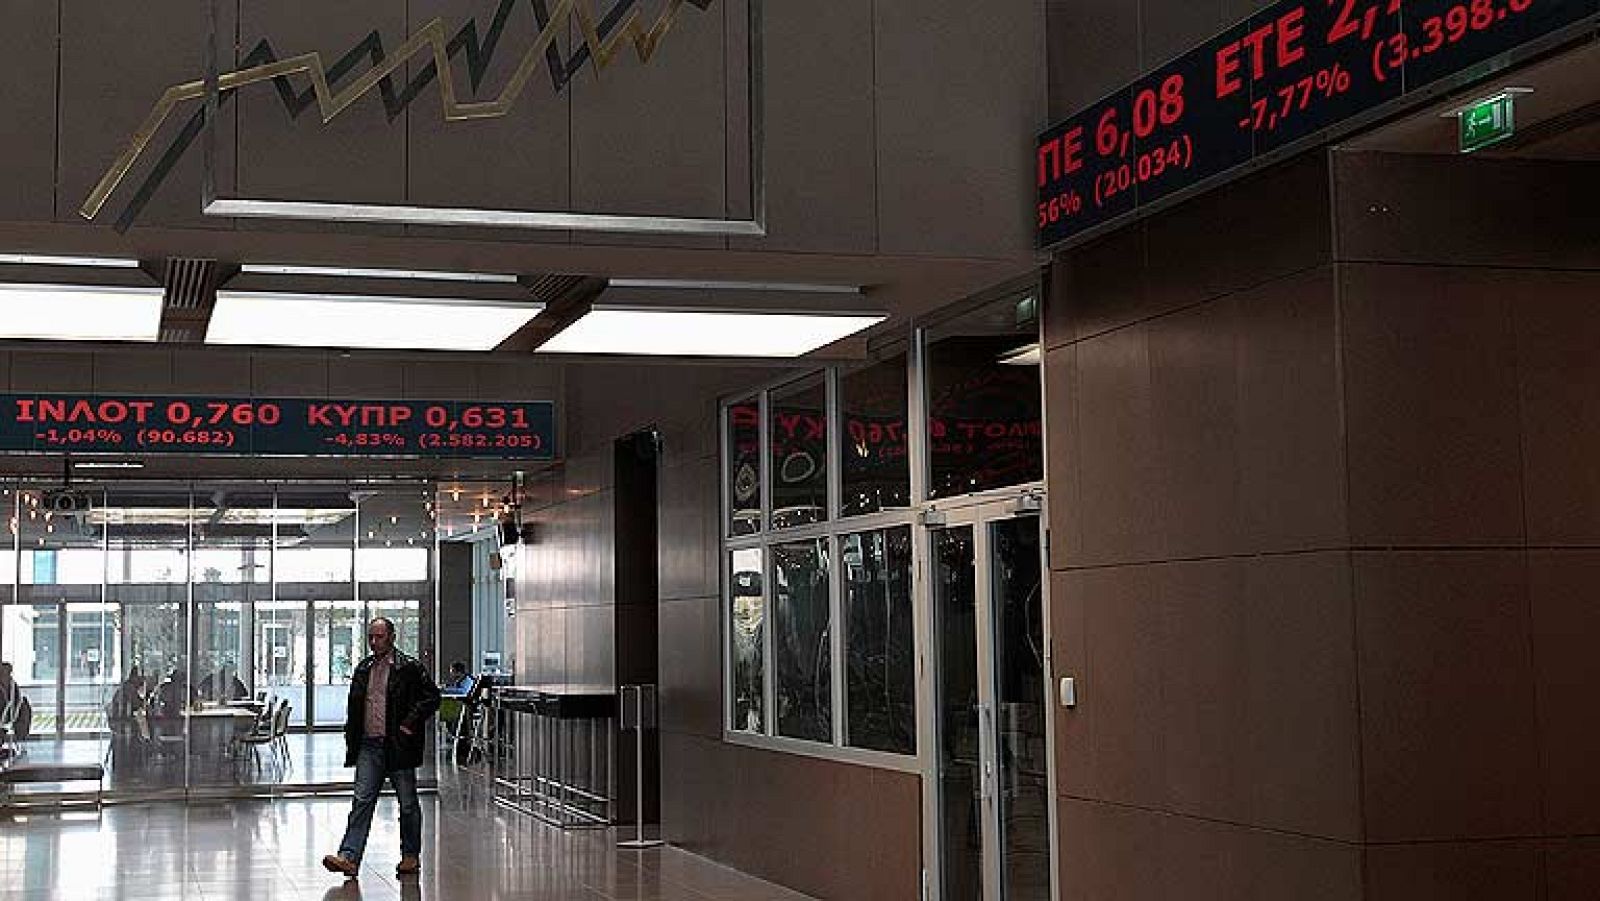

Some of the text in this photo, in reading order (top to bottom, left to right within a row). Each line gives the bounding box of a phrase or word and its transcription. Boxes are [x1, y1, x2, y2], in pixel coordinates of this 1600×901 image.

[1095, 73, 1185, 158] 6,08
[1215, 6, 1306, 100] ΕΤΕ
[1327, 0, 1402, 44] 2,
[1094, 134, 1194, 206] (20.034)
[1238, 63, 1351, 130] -7,77%
[16, 399, 529, 430] ΙΝΛΟΤ 0,760 ΚΥΠΡ 0,631
[35, 429, 122, 445] -1,04%
[137, 428, 235, 446] (90.682)
[324, 432, 405, 449] -4,83%
